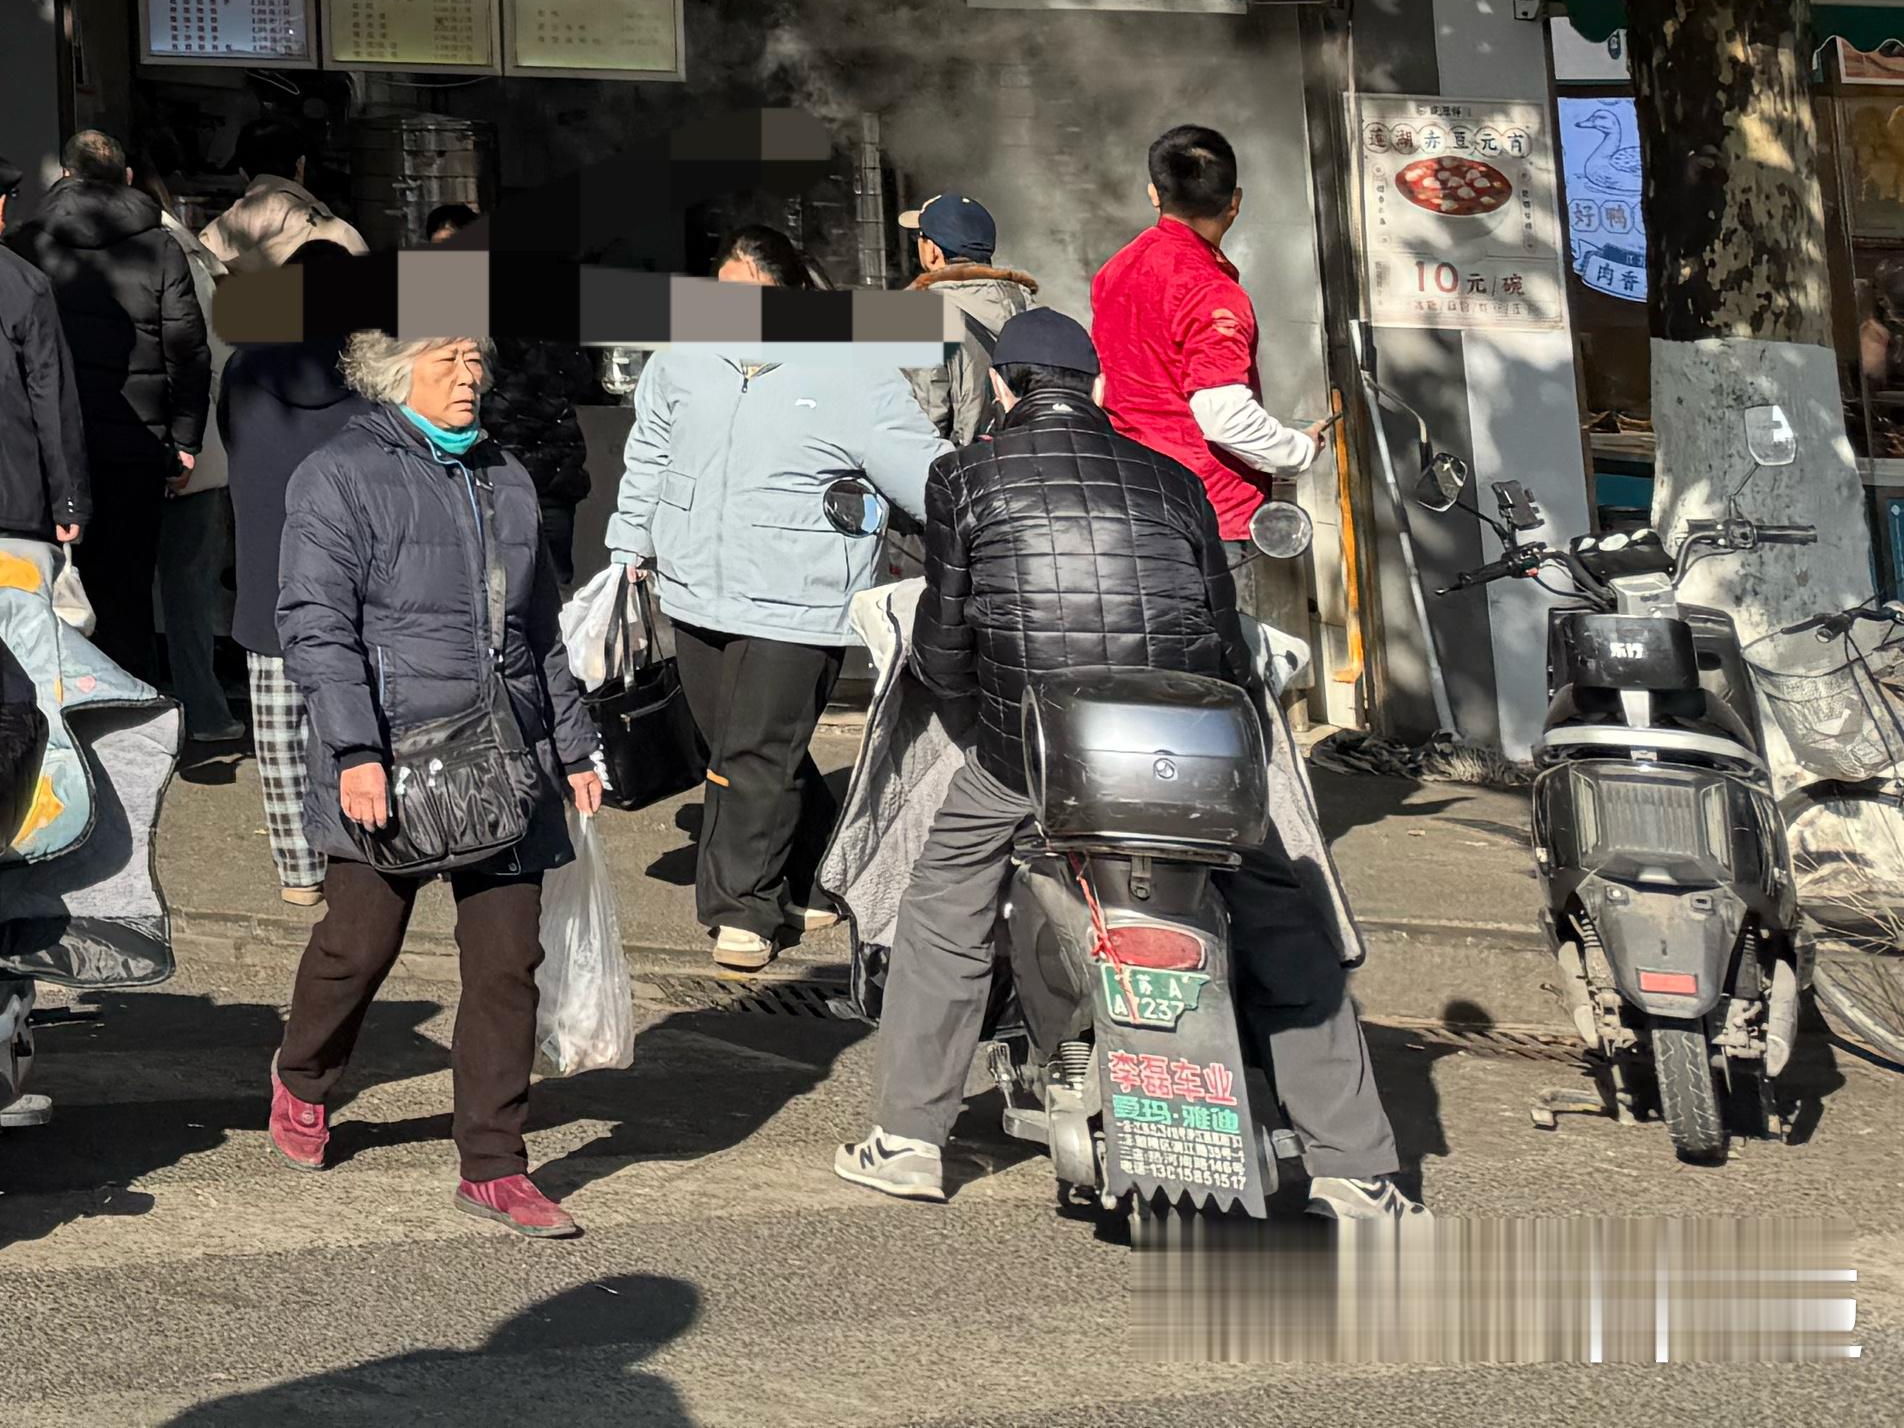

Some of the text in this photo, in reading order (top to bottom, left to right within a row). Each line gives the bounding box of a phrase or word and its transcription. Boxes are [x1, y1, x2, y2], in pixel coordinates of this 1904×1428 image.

[1571, 201, 1628, 230] 好鸭
[1596, 262, 1639, 292] 肉香
[1107, 1049, 1238, 1106] 李磊车业
